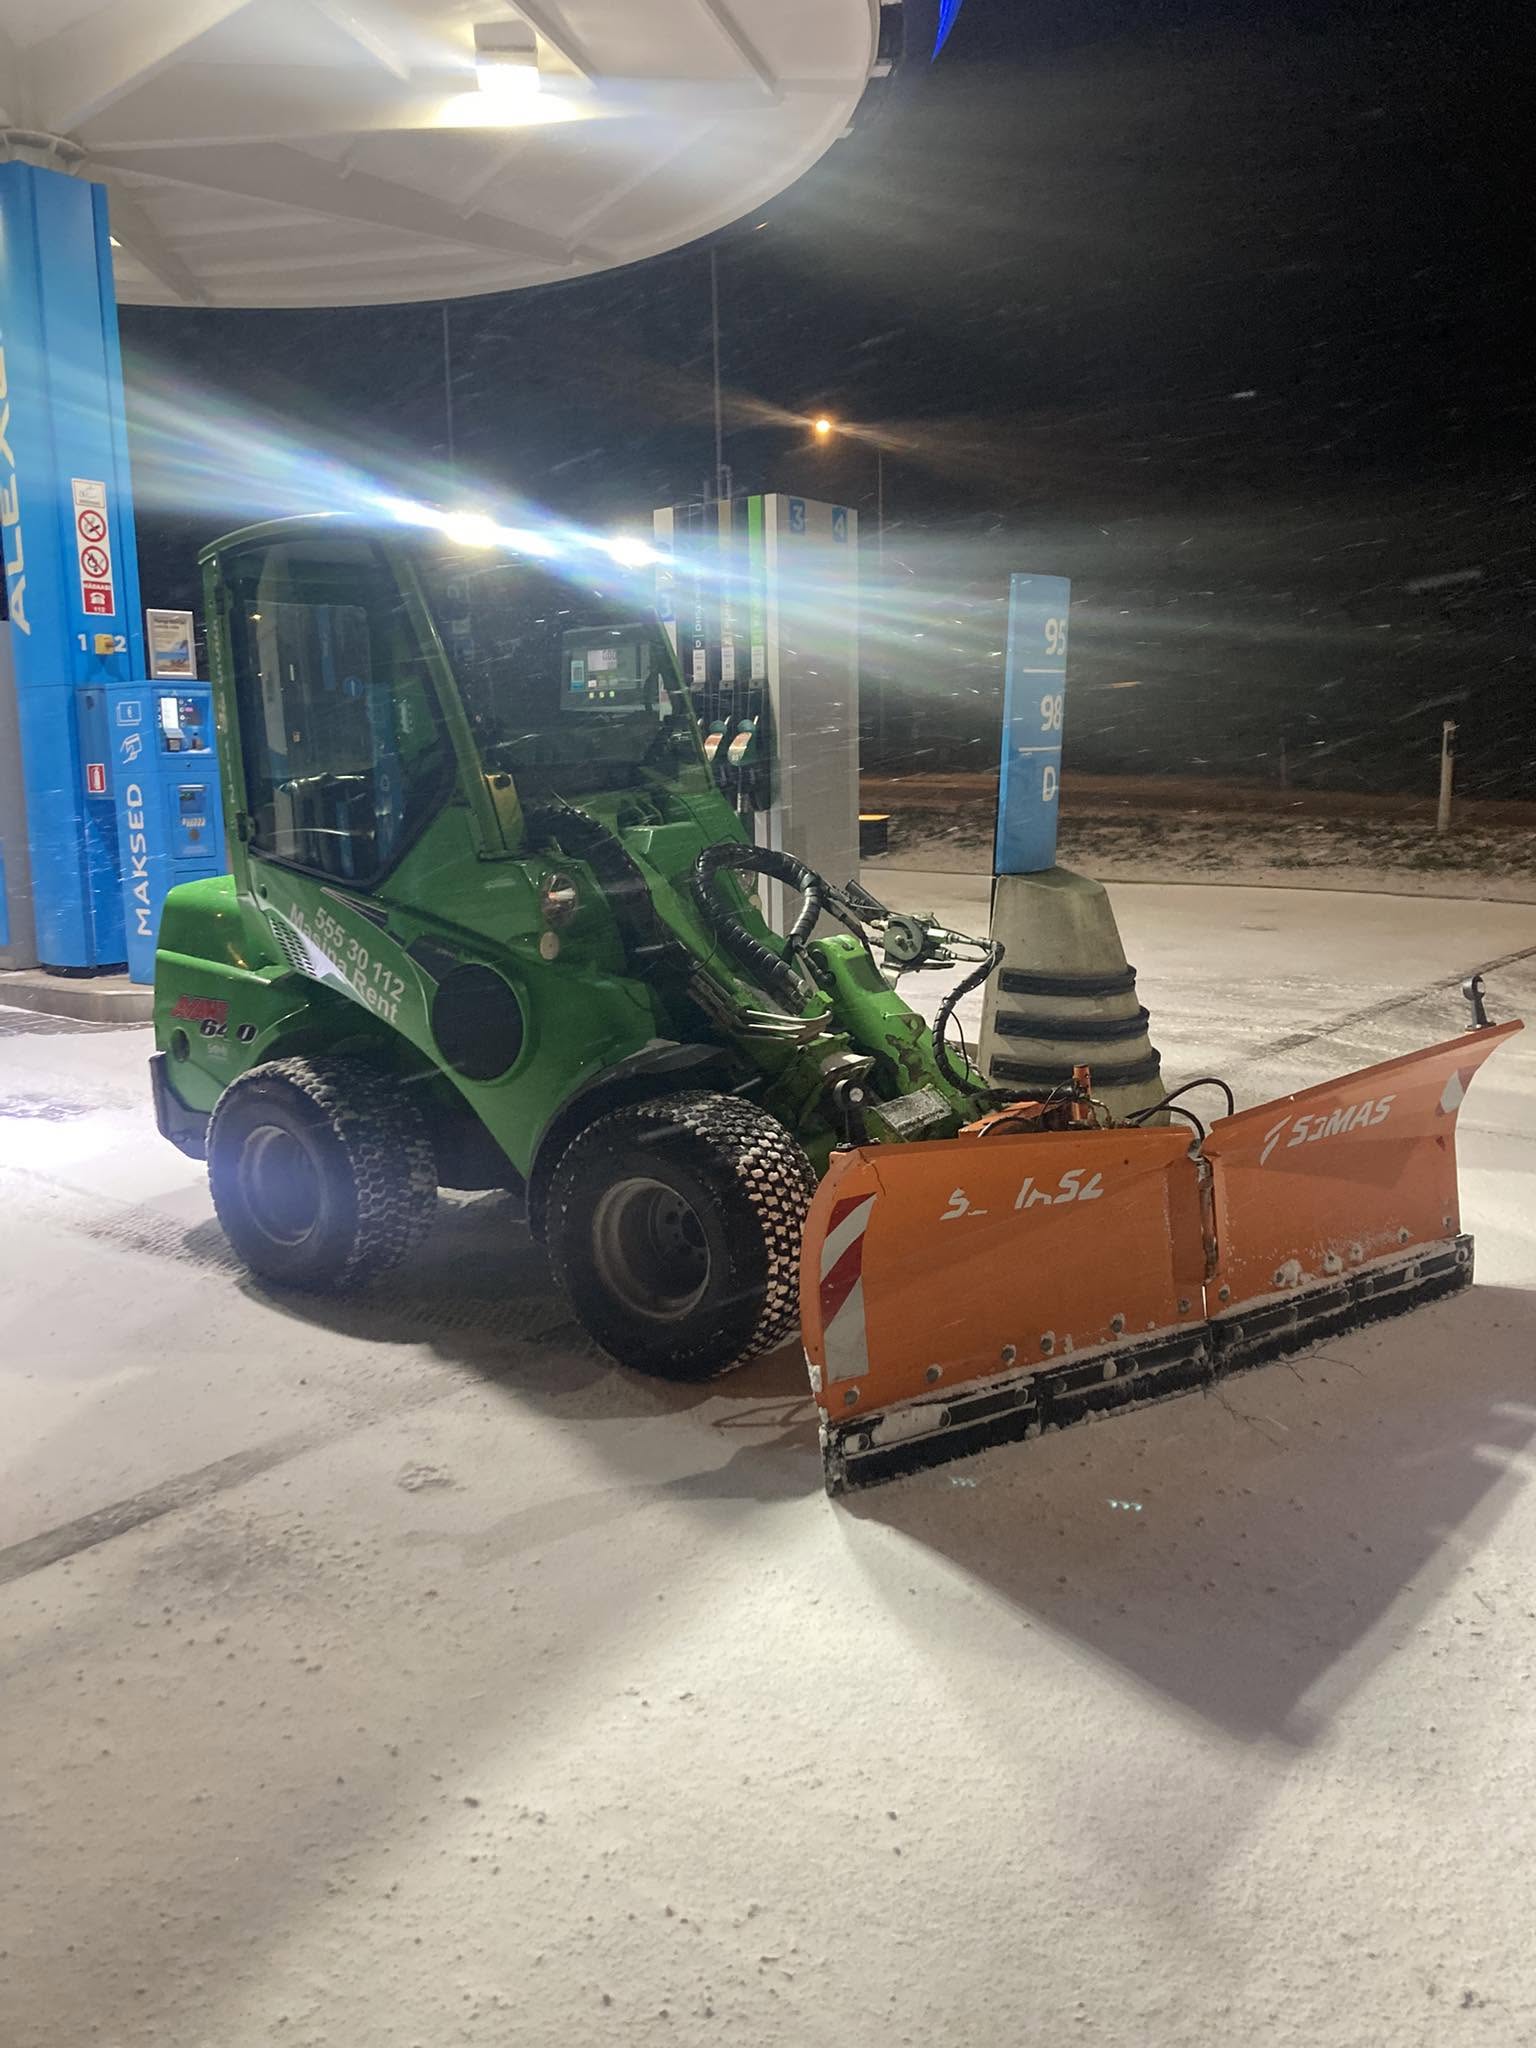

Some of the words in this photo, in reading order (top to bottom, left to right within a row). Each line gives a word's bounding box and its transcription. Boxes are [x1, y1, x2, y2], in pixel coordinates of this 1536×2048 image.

[792, 505, 803, 530] 3
[834, 511, 844, 537] 4
[77, 634, 87, 651] 1
[114, 636, 127, 652] 2
[1044, 618, 1067, 655] 95
[1040, 695, 1063, 731] 98
[1042, 766, 1057, 801] D
[127, 784, 153, 936] MAKSED
[289, 902, 347, 976] Masina
[353, 968, 398, 1023] Rent
[315, 907, 346, 948] 555
[347, 939, 369, 970] 30
[373, 962, 405, 1002] 112
